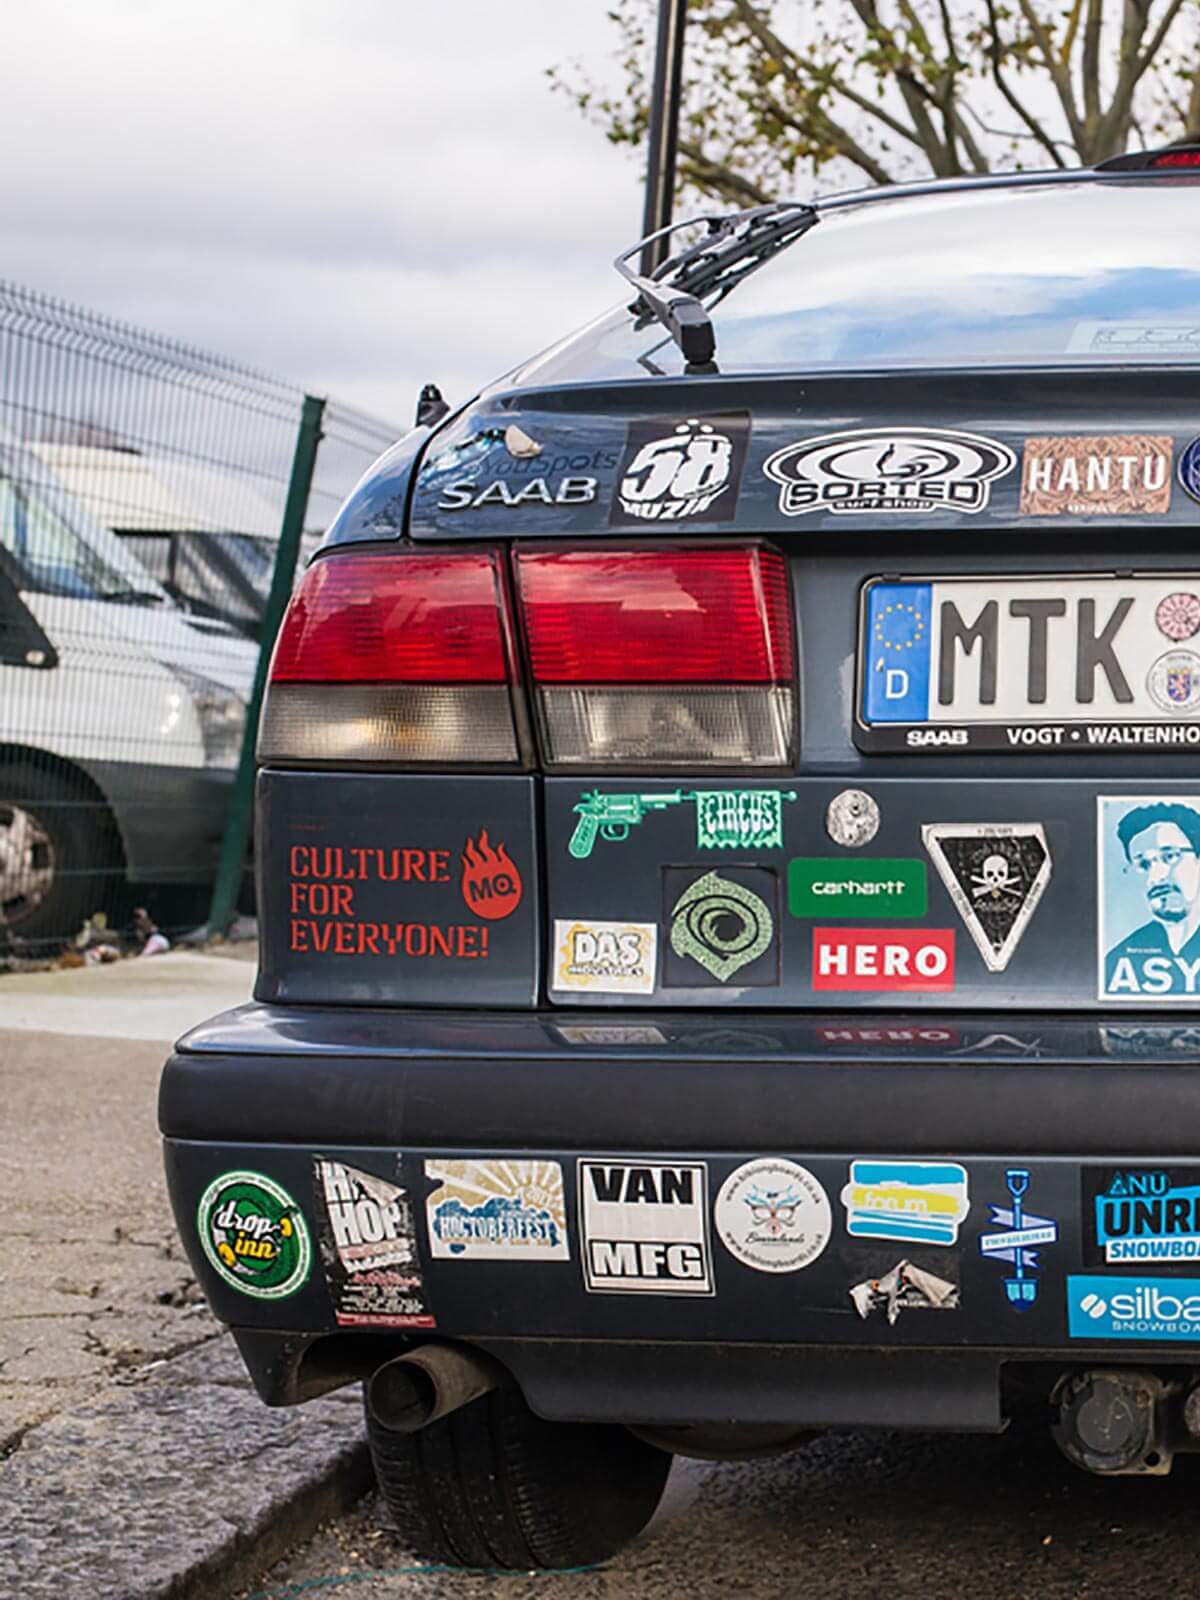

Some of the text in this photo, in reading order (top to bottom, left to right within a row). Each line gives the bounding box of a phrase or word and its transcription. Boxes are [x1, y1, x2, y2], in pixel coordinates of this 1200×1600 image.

[621, 433, 732, 501] 58
[1029, 456, 1165, 492] HANTU
[438, 478, 597, 509] SAAB
[790, 481, 980, 507] SORTED
[938, 598, 1136, 705] MTK
[886, 670, 909, 698] D
[907, 729, 969, 745] SAAB
[1007, 727, 1065, 744] VOGT
[704, 793, 775, 834] CIRCUS
[290, 846, 450, 881] CULTURE
[290, 883, 355, 916] FOR
[811, 880, 906, 896] carhartt
[290, 919, 489, 958] EVERYONE!
[573, 931, 642, 967] DAS
[818, 944, 948, 977] HERO
[590, 1166, 694, 1205] VAN
[216, 1200, 280, 1239] drop
[328, 1200, 401, 1247] HOP
[235, 1231, 278, 1259] inn
[591, 1241, 705, 1279] MFG
